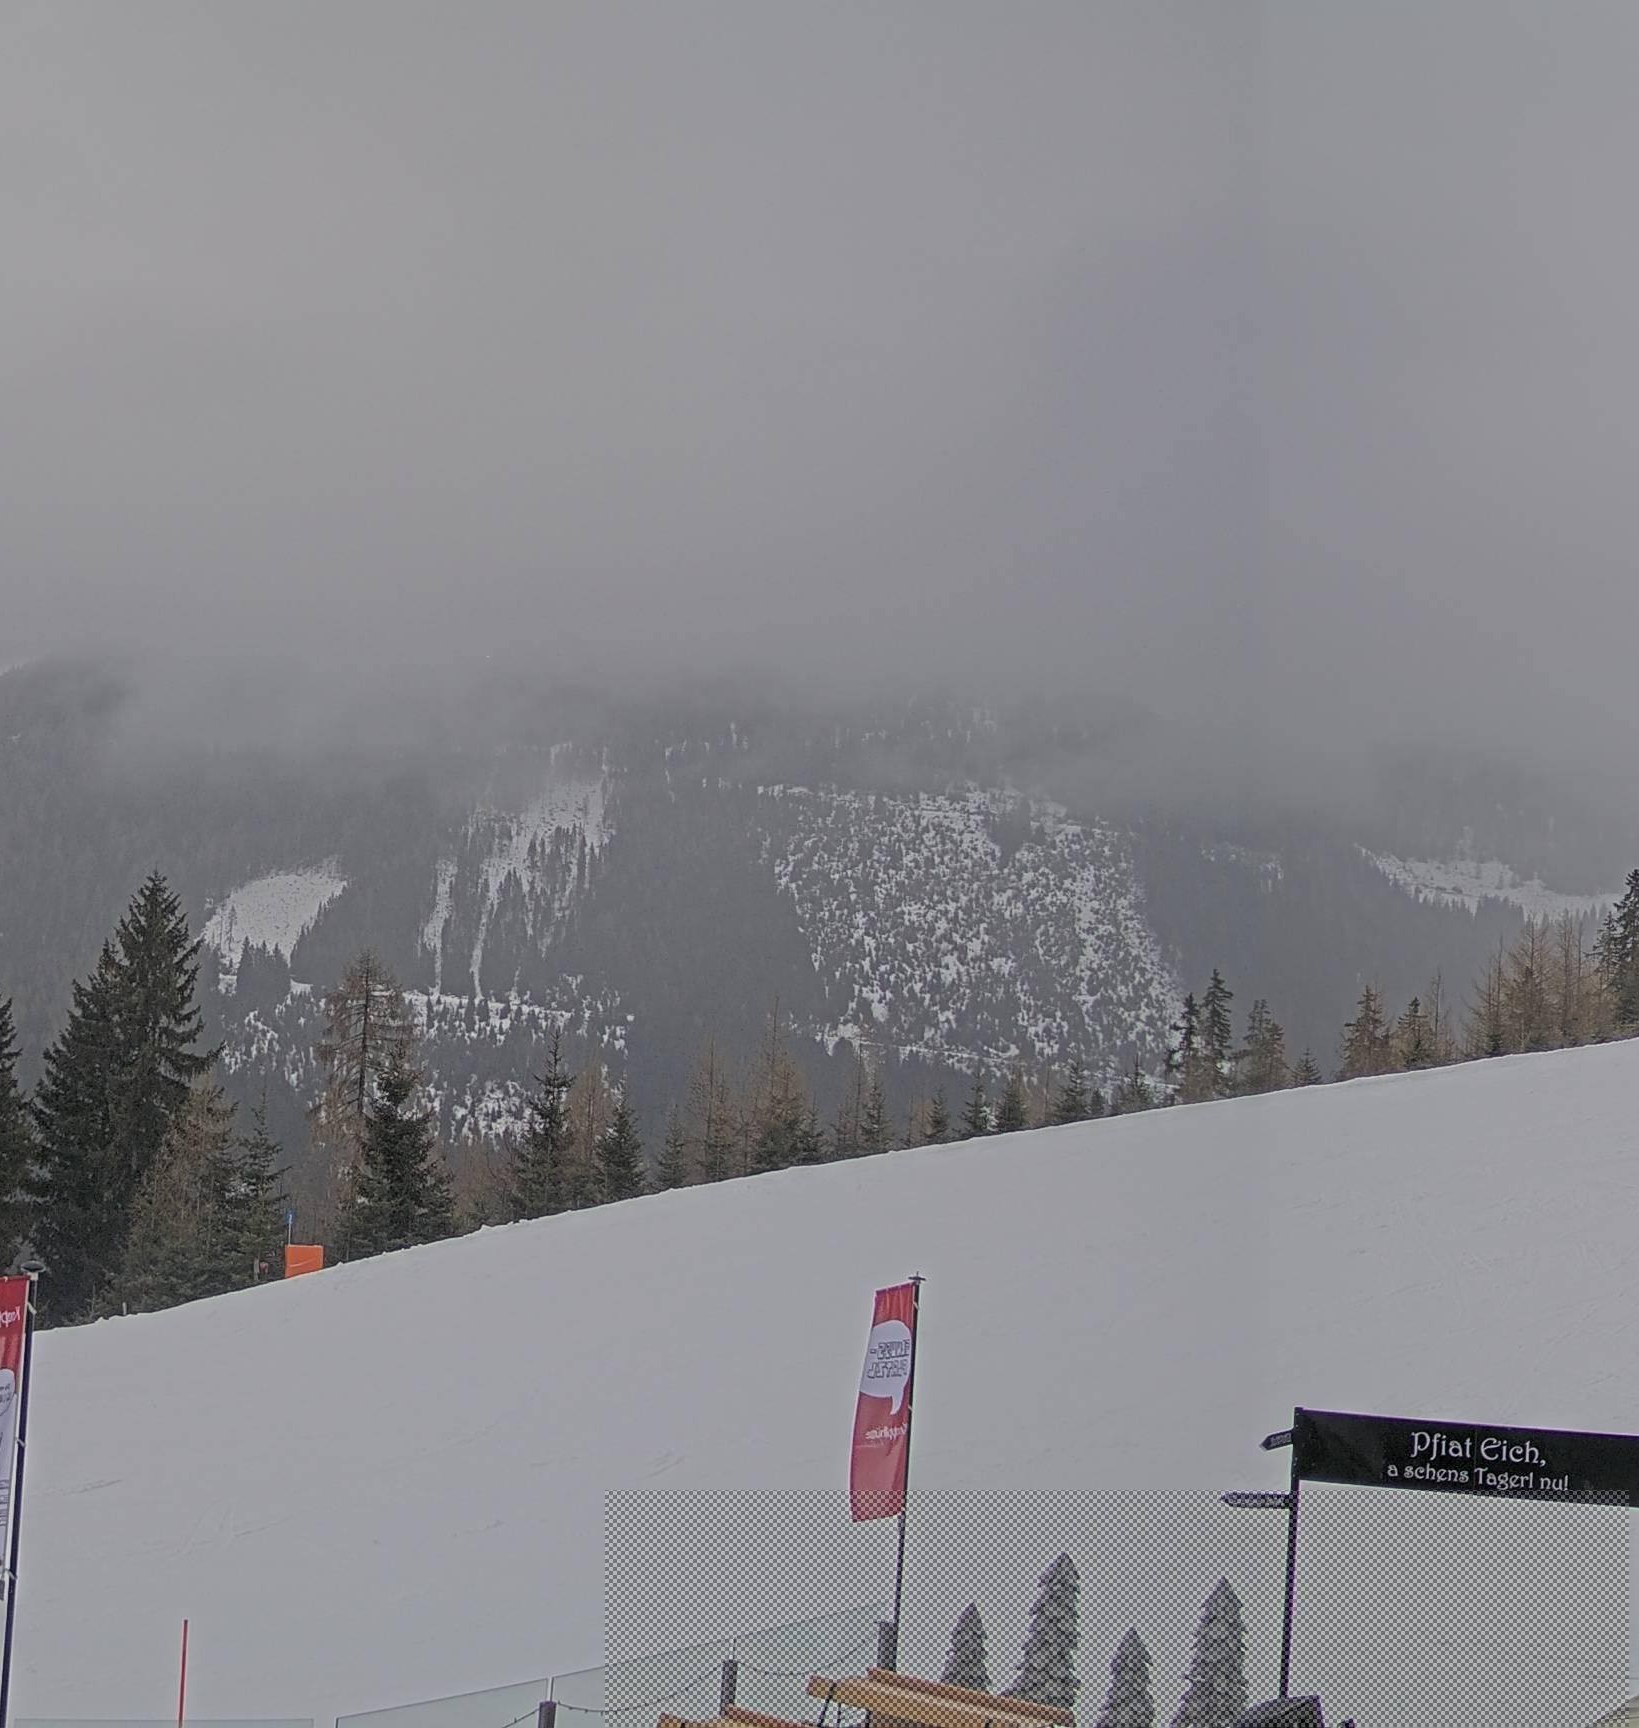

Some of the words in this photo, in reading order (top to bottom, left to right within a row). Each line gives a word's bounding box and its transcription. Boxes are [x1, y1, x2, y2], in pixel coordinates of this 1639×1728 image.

[1410, 1431, 1472, 1461] Pfiat
[1480, 1437, 1547, 1467] Eich,
[1387, 1464, 1398, 1477] a
[1403, 1462, 1470, 1483] schens
[1474, 1467, 1534, 1490] Tagerl
[1540, 1474, 1569, 1491] nu!
